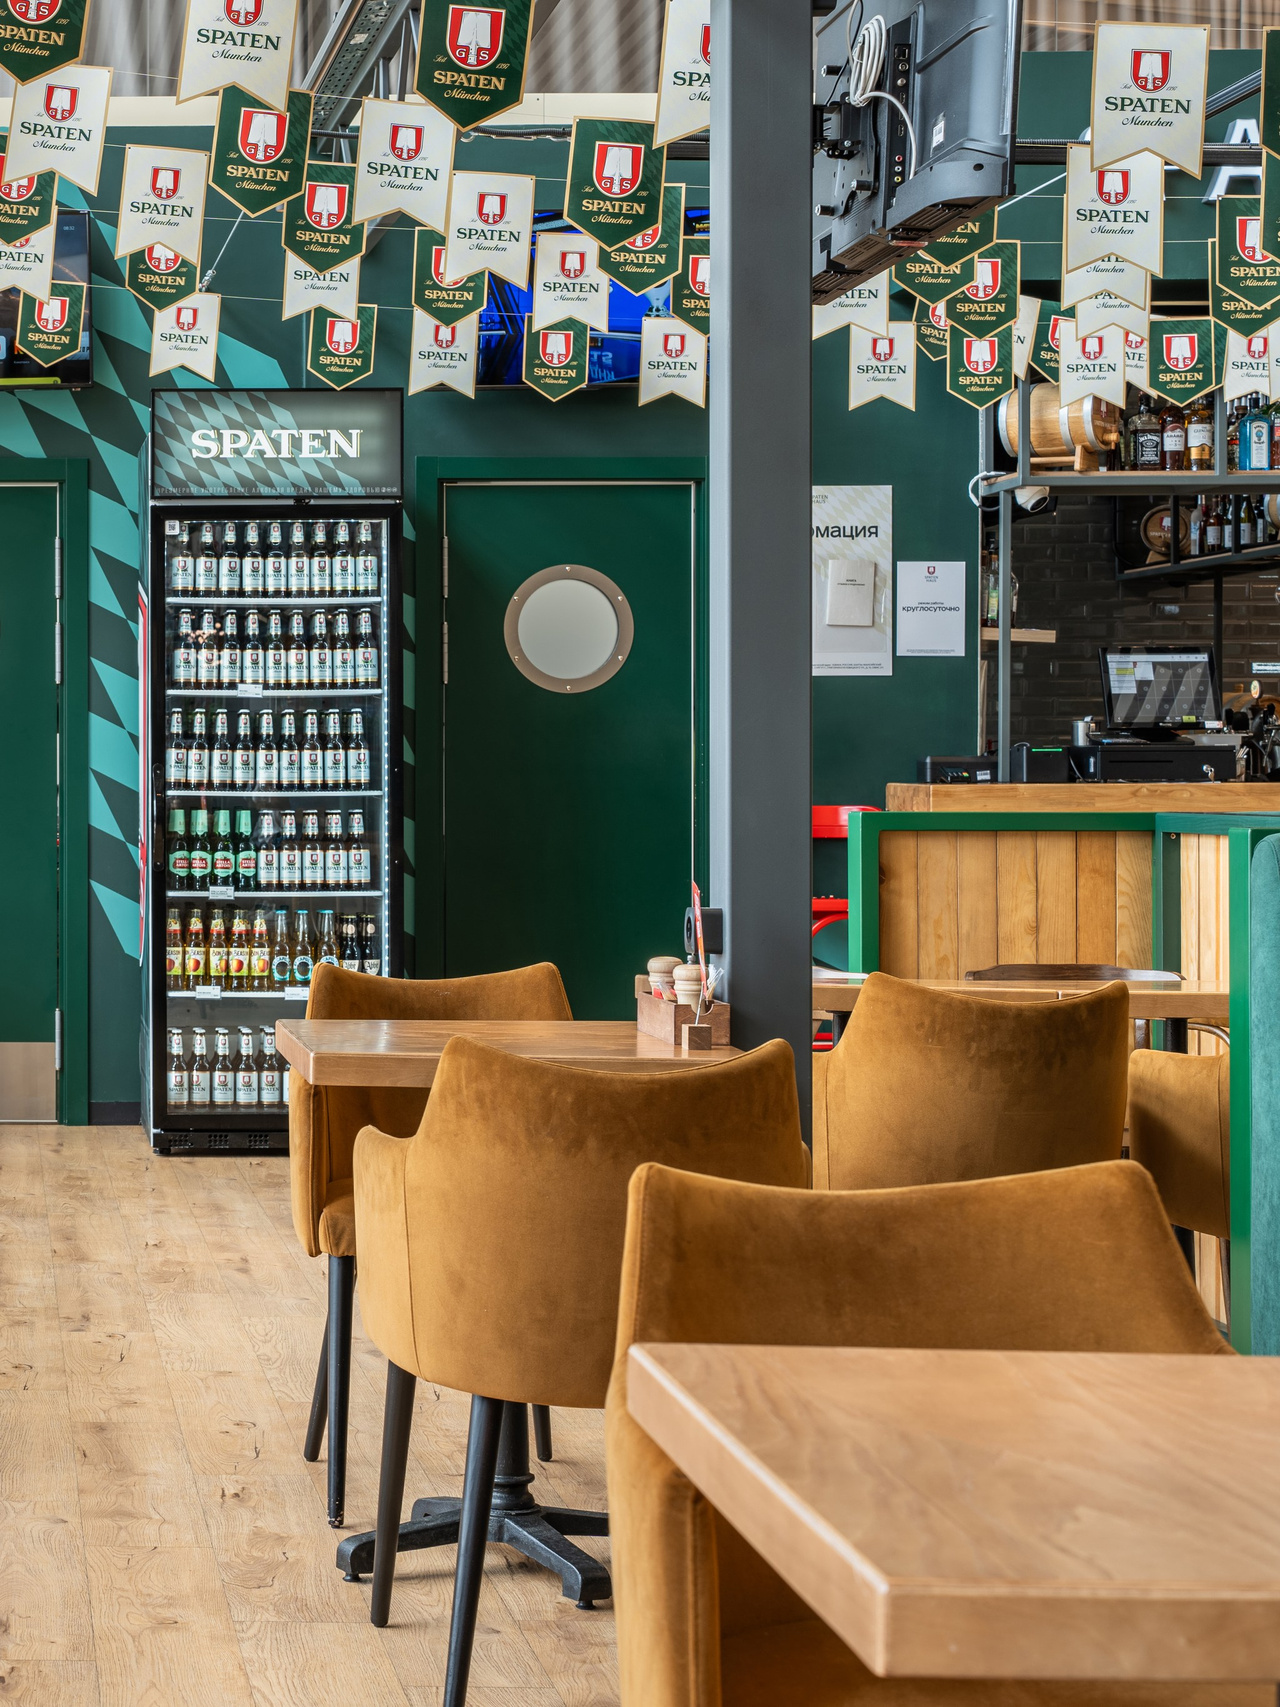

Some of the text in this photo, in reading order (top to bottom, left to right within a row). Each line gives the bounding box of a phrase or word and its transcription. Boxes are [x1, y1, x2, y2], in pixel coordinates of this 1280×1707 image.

[17, 2, 49, 16] G S
[196, 28, 281, 50] SPATEN
[3, 42, 50, 57] München
[456, 48, 489, 60] G S
[434, 70, 506, 90] SPATEN
[673, 71, 710, 87] SPA
[444, 88, 490, 102] München
[1105, 97, 1191, 114] SPATEN
[20, 121, 92, 142] SPATEN
[246, 146, 276, 157] G S
[226, 164, 290, 182] SPATEN
[366, 162, 440, 181] SPATEN
[235, 180, 276, 192] München
[601, 180, 631, 189] G S
[129, 201, 193, 218] SPATEN
[582, 199, 646, 215] SPATEN
[591, 214, 633, 225] München
[1076, 208, 1150, 223] SPATEN
[296, 231, 351, 245] SPATEN
[456, 228, 521, 242] SPATEN
[610, 252, 666, 265] SPATEN
[138, 274, 186, 286] SPATEN
[294, 270, 350, 283] SPATEN
[543, 281, 600, 293] SPATEN
[424, 290, 473, 301] SPATEN
[682, 299, 710, 308] SPAT
[956, 303, 1006, 313] SPATEN
[28, 332, 70, 344] SPATEN
[160, 332, 209, 345] SPATEN
[920, 326, 948, 339] SPAT
[319, 356, 362, 366] SPATEN
[418, 351, 468, 362] SPATEN
[648, 361, 697, 371] SPATEN
[857, 365, 906, 374] SPATEN
[1067, 364, 1116, 373] SPATEN
[1232, 361, 1269, 370] SPATE
[534, 368, 576, 377] SPATEN
[1158, 372, 1203, 382] SPATEN
[959, 376, 1002, 385] SPATEN
[191, 429, 364, 458] SPATEN
[812, 526, 878, 540] мация
